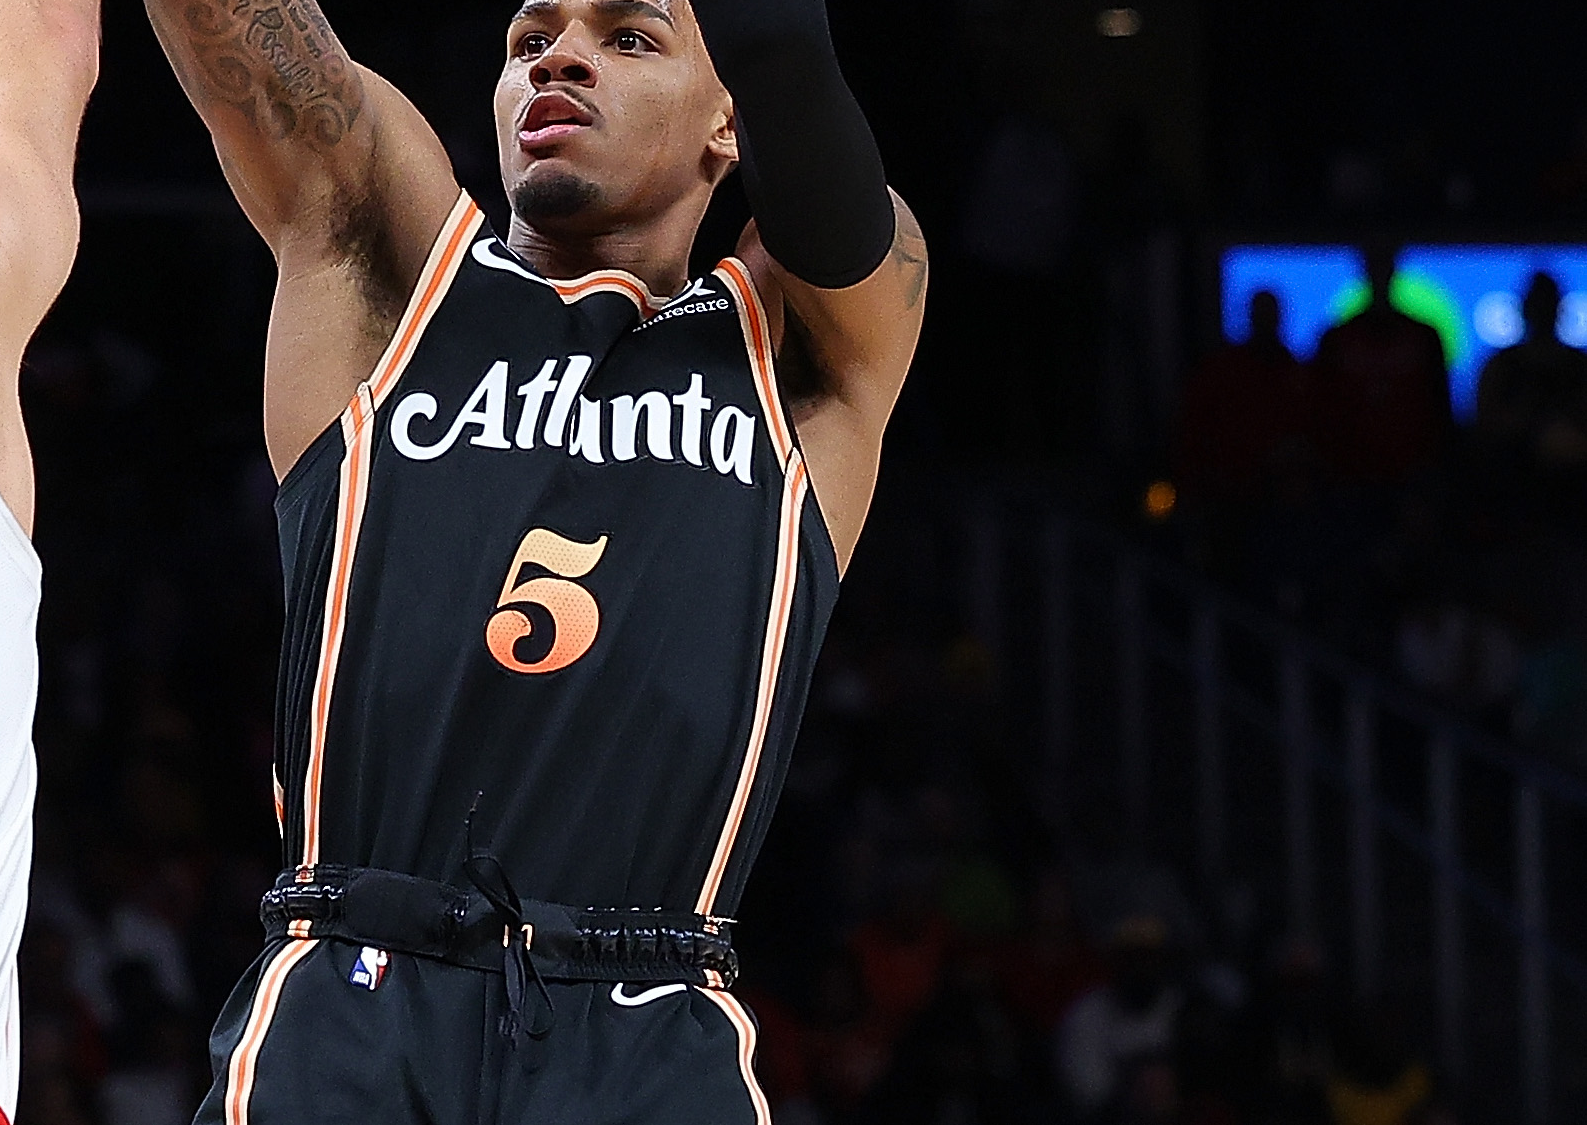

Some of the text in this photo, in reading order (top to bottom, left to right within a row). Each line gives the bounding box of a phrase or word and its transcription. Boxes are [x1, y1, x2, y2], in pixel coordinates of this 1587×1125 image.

[632, 298, 730, 333] arecare
[390, 355, 756, 485] Atlanta
[485, 528, 608, 673] 5
